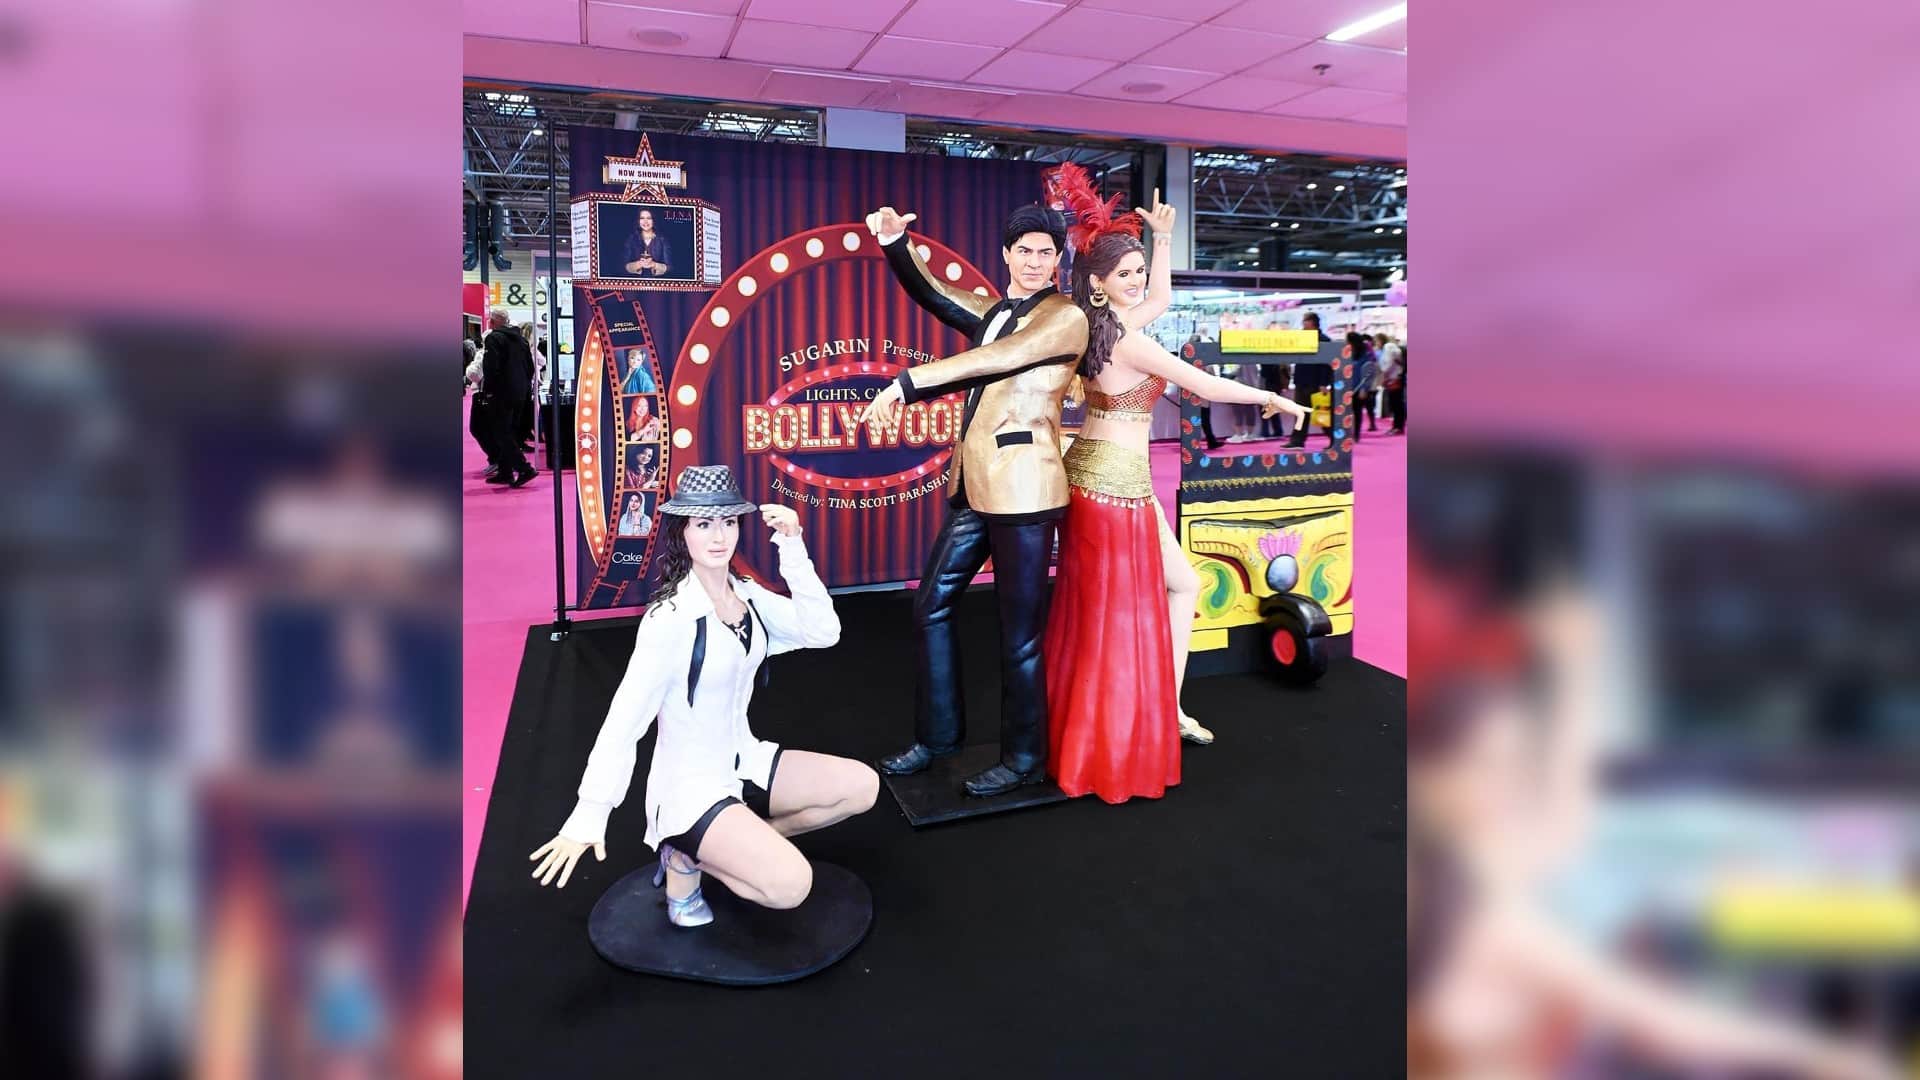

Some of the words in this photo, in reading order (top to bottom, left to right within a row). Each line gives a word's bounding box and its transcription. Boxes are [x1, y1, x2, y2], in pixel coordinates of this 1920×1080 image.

[618, 169, 635, 177] NOW
[637, 171, 672, 180] SHOWING
[506, 283, 528, 305] &
[779, 338, 871, 372] SUGARIN
[806, 388, 861, 402] LIGHTS,
[770, 478, 809, 504] Directed
[810, 495, 825, 508] by:
[827, 497, 857, 509] TINA
[859, 495, 897, 509] SCOTT
[611, 551, 643, 564] Cake
